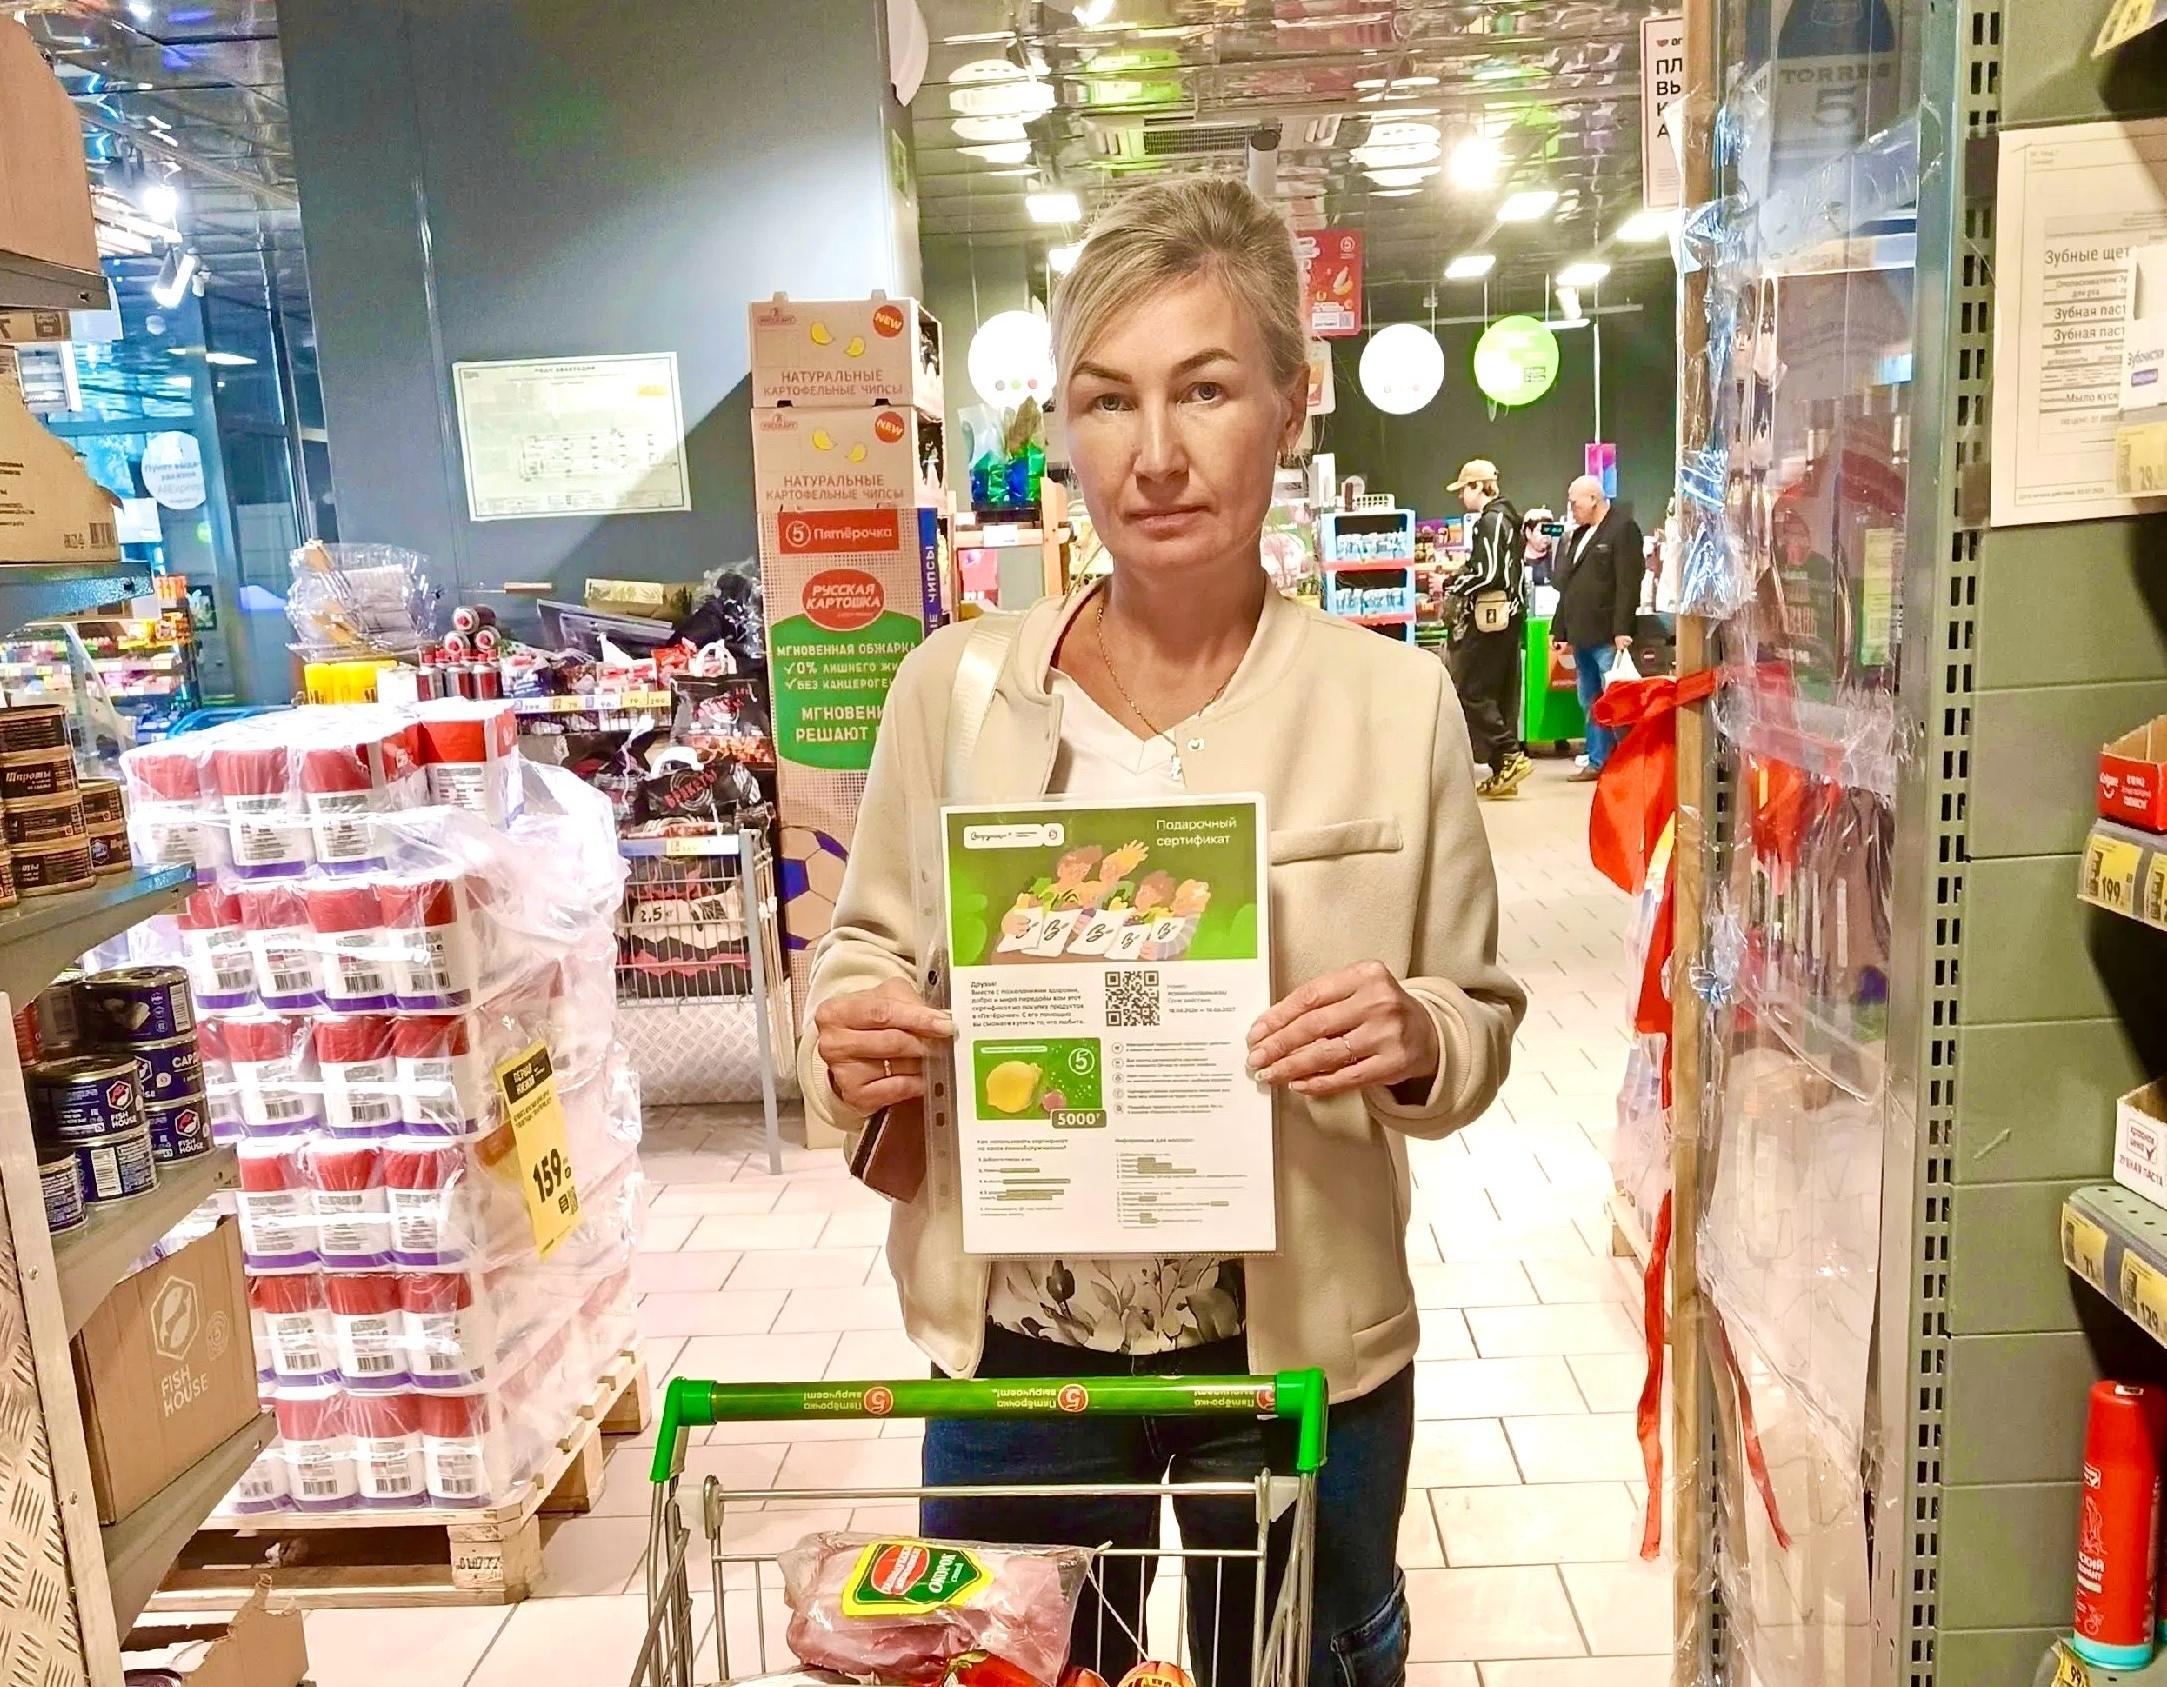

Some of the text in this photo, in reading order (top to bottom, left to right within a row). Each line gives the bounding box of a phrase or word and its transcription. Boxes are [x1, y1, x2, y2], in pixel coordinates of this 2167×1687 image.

[2044, 249, 2099, 268] Зубные
[874, 312, 903, 331] NEW
[2053, 306, 2097, 323] Зубная
[2053, 328, 2096, 344] Зубная
[781, 370, 884, 383] НАТУРАЛЬНЫЕ
[763, 384, 904, 396] КАРТОФЕЛЬНЫЕ ЧИПСЫ
[876, 419, 903, 436] NEW
[783, 475, 885, 488] НАТУРАЛЬНЫЕ
[766, 488, 904, 500] КАРТОФЕЛЬНЫЕ ЧИПСЫ
[792, 525, 892, 543] 5 Пятёрочка
[925, 545, 938, 603] ЧИПСЫ
[812, 583, 876, 597] РУССКАЯ
[805, 596, 881, 610] КАРТОШКА
[776, 643, 855, 657] МГНОВЕННАЯ
[796, 661, 898, 674] 0% ЛИШНЕГО ЖИ
[796, 678, 893, 691] БЕЗ КАНЦЕРОГЕ
[795, 726, 869, 742] РЕШАЮТ
[5, 771, 51, 783] Шпроты
[1156, 816, 1238, 833] Подарочный
[1156, 834, 1231, 848] сертификат
[1074, 1051, 1088, 1070] 5
[110, 1110, 130, 1123] FISH
[111, 1115, 138, 1129] HOUSE
[178, 1141, 205, 1155] HOUSE
[532, 1148, 562, 1203] 159
[160, 1363, 192, 1398] FISH
[163, 1372, 209, 1418] HOUSE
[803, 1389, 863, 1400] выручает!
[995, 1387, 1057, 1398] выручает!
[803, 1401, 863, 1411] Пятёрочка
[996, 1398, 1057, 1409] Пятёрочка
[1193, 1397, 1255, 1409] Пятёрочка
[928, 1553, 957, 1594] ОКОРОК
